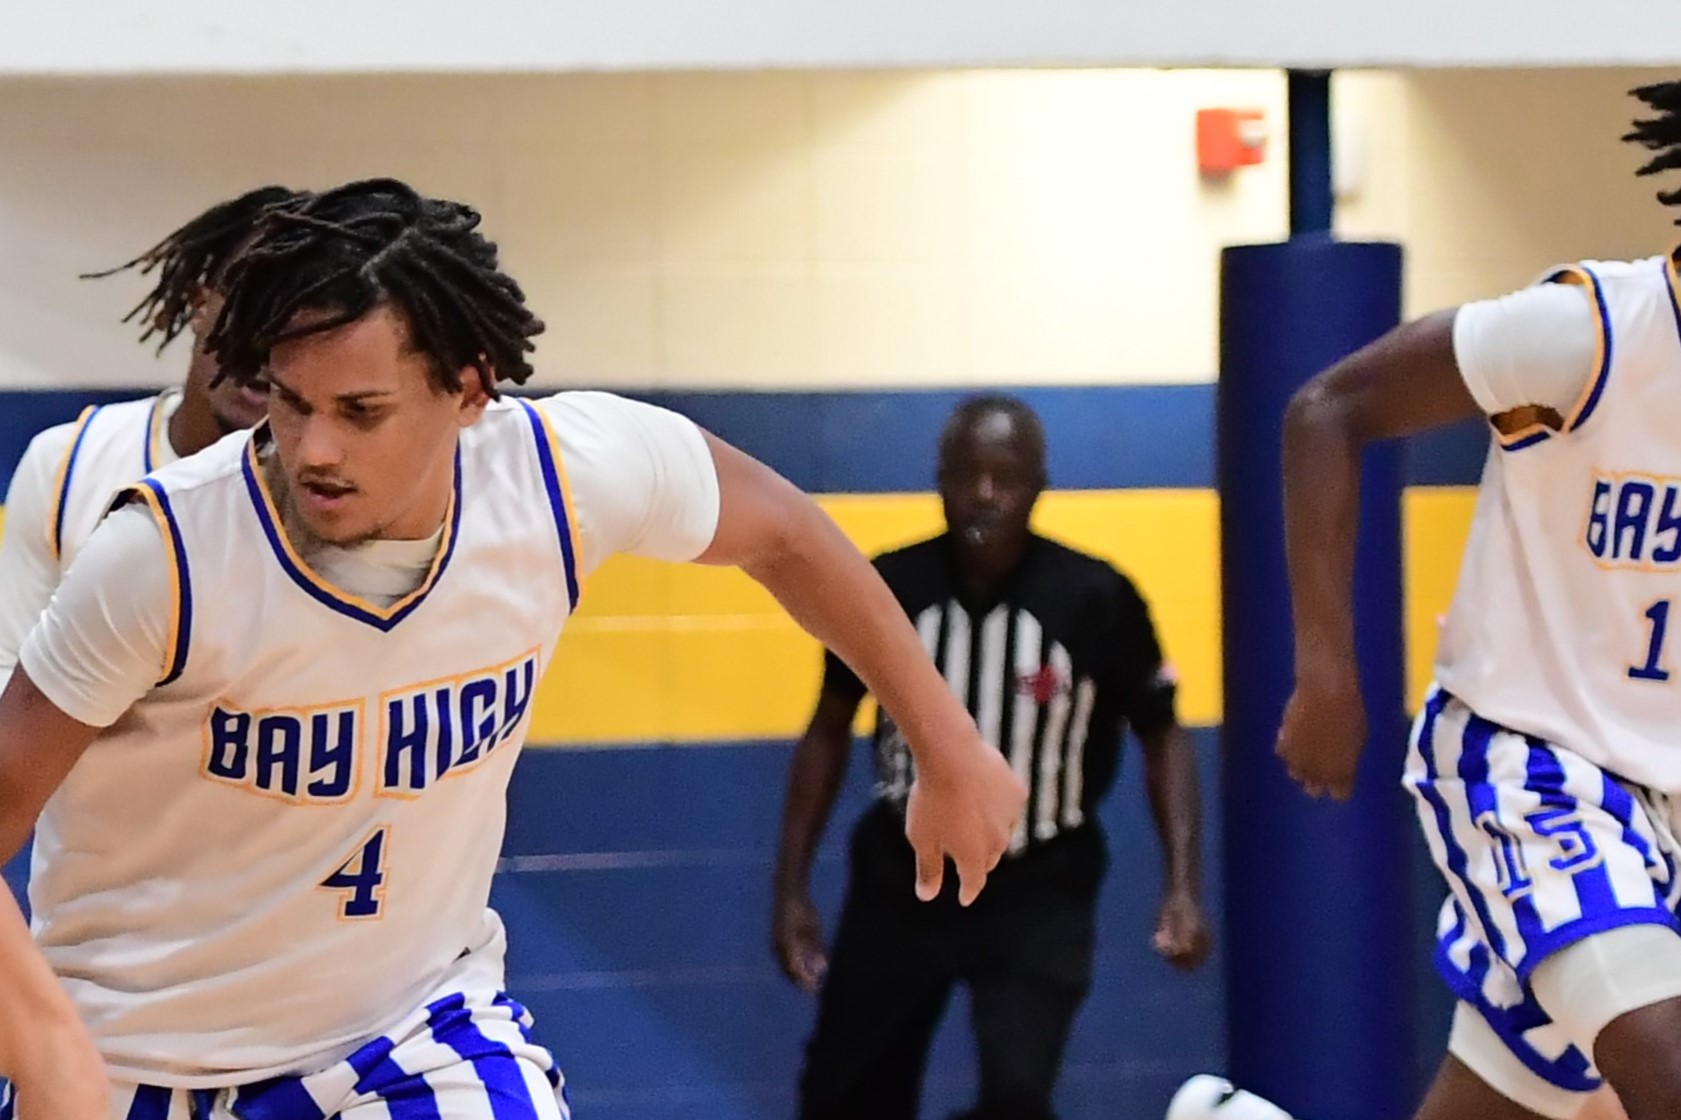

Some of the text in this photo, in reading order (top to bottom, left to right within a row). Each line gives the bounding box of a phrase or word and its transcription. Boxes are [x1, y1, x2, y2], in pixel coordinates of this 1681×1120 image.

[206, 657, 535, 799] BAY HIGH
[320, 828, 384, 917] 4
